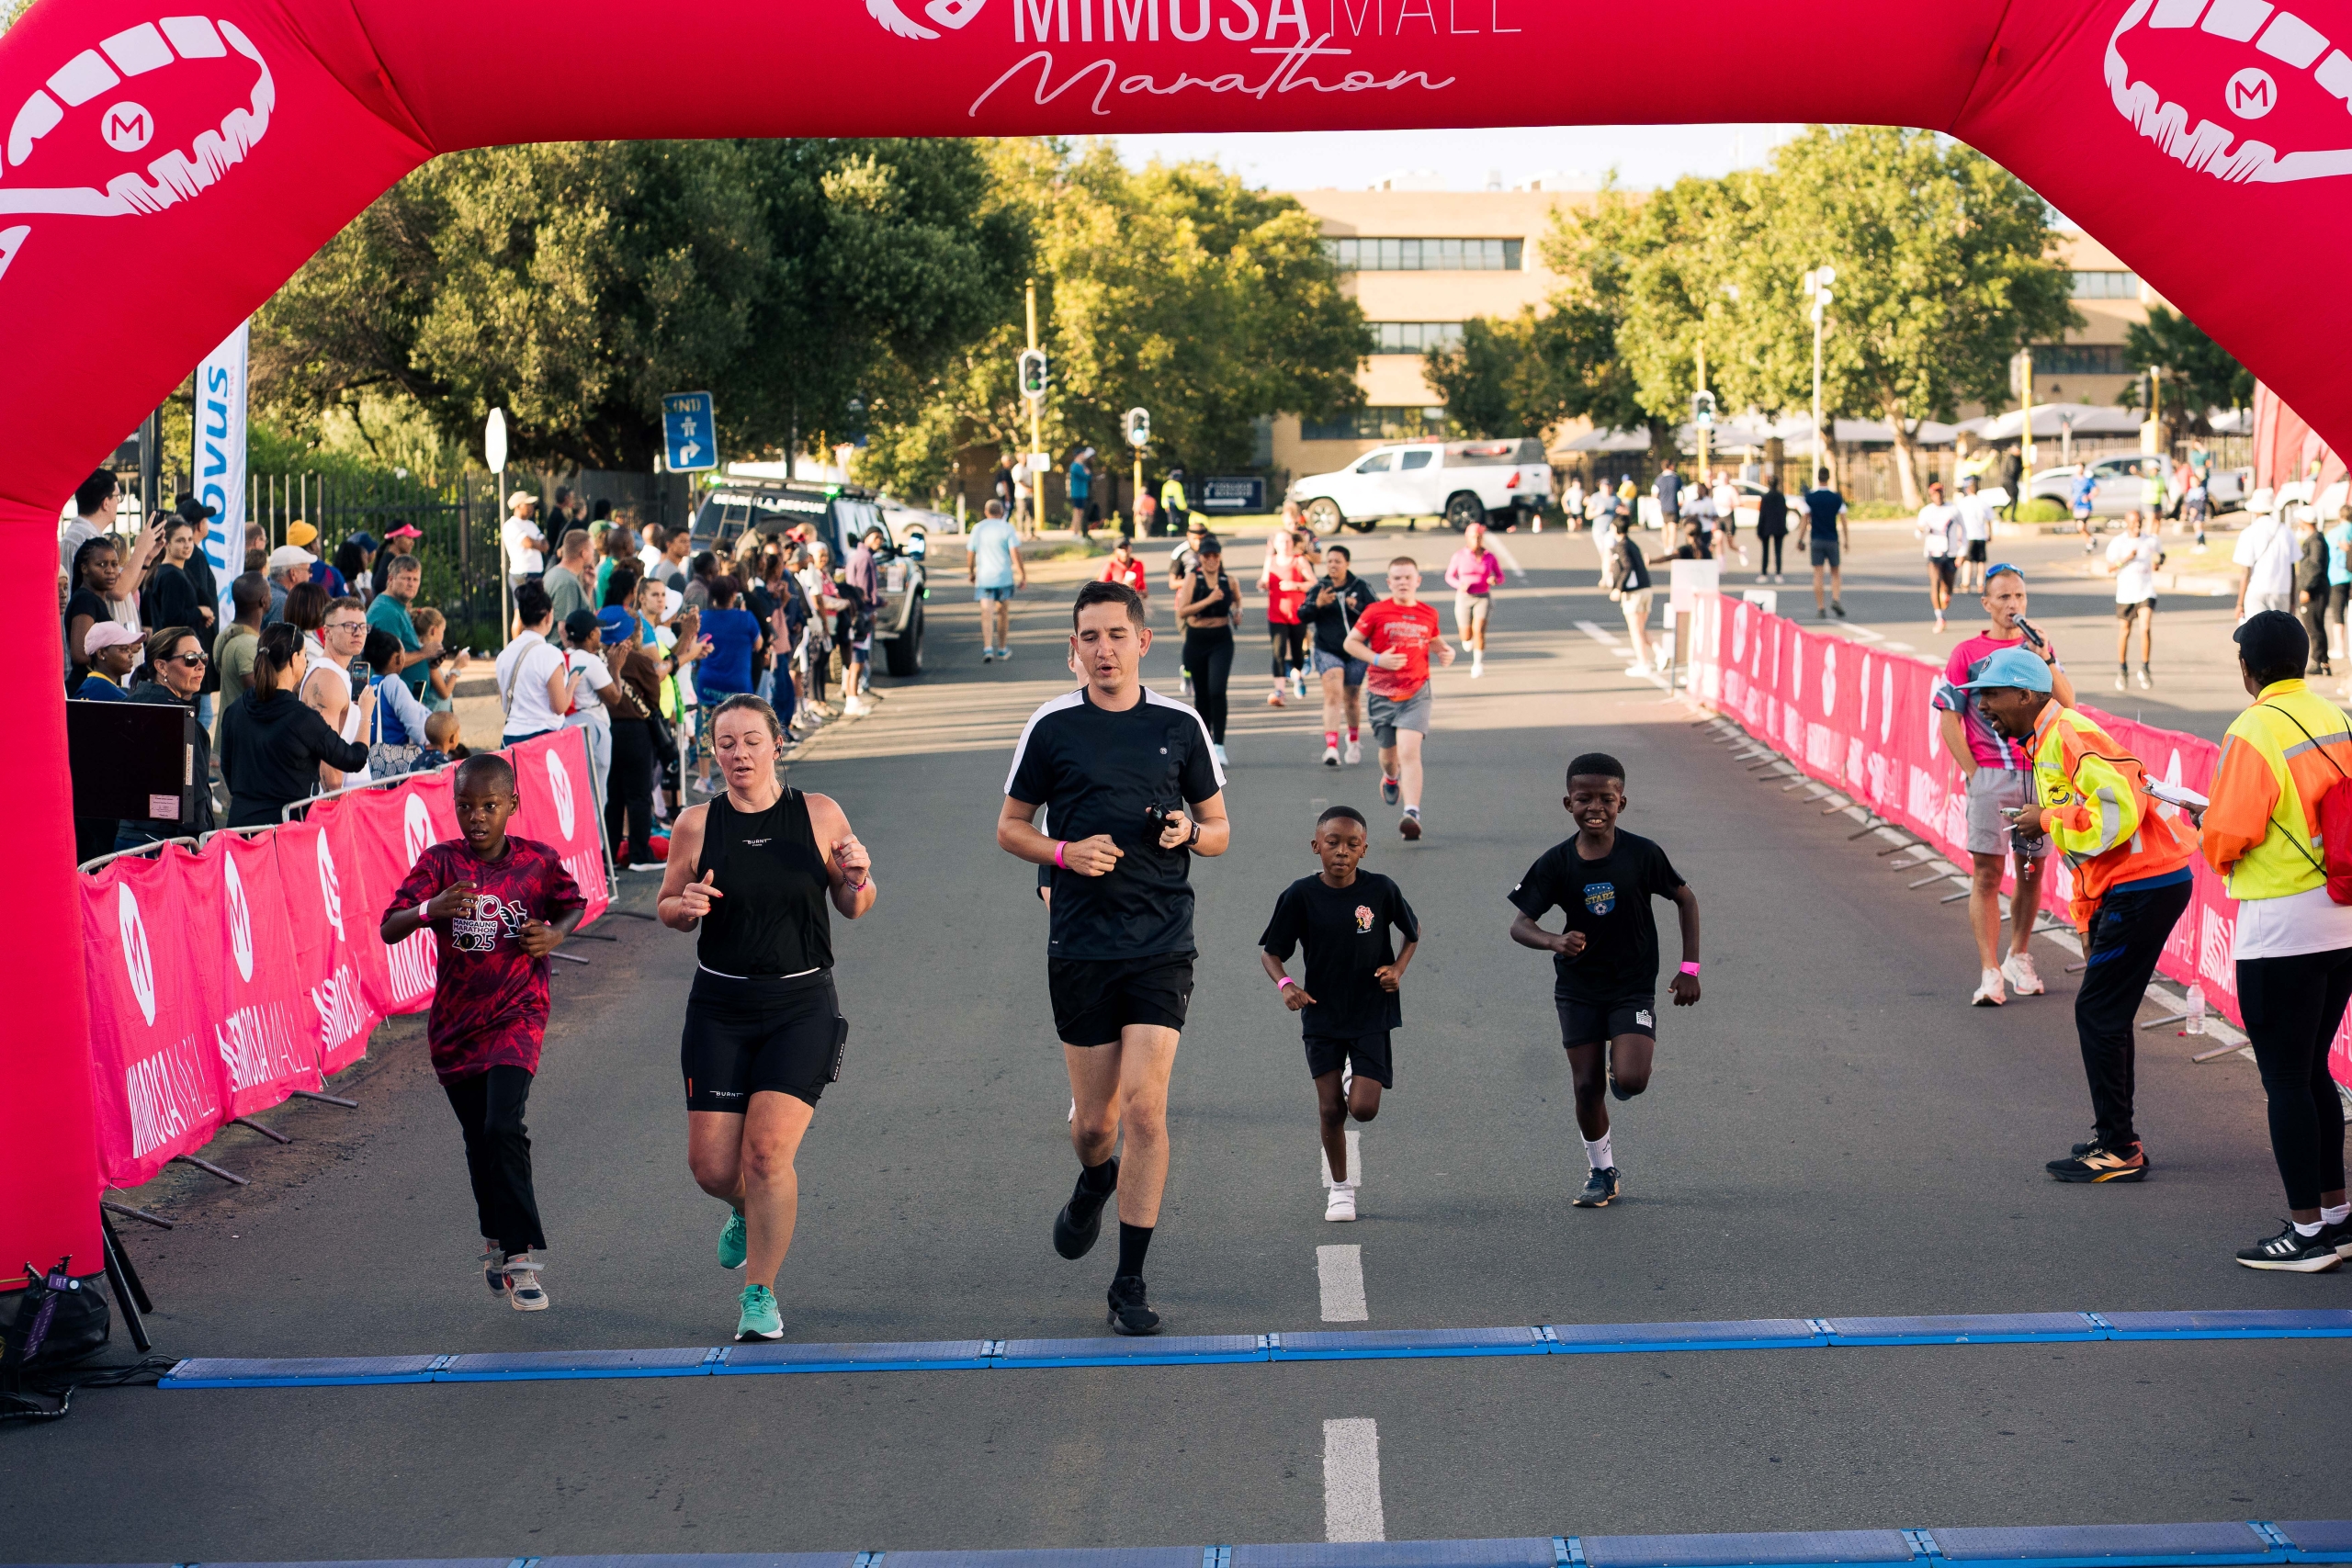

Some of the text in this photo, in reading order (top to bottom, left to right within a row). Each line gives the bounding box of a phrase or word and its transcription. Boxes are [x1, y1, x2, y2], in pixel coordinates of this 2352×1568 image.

[968, 32, 1456, 117] Marathon
[2234, 78, 2268, 108] M
[111, 113, 143, 141] M
[777, 499, 827, 514] RESCUE
[1585, 891, 1615, 905] STARZ
[453, 919, 497, 928] MANGAUNG
[453, 925, 496, 933] MARATHON
